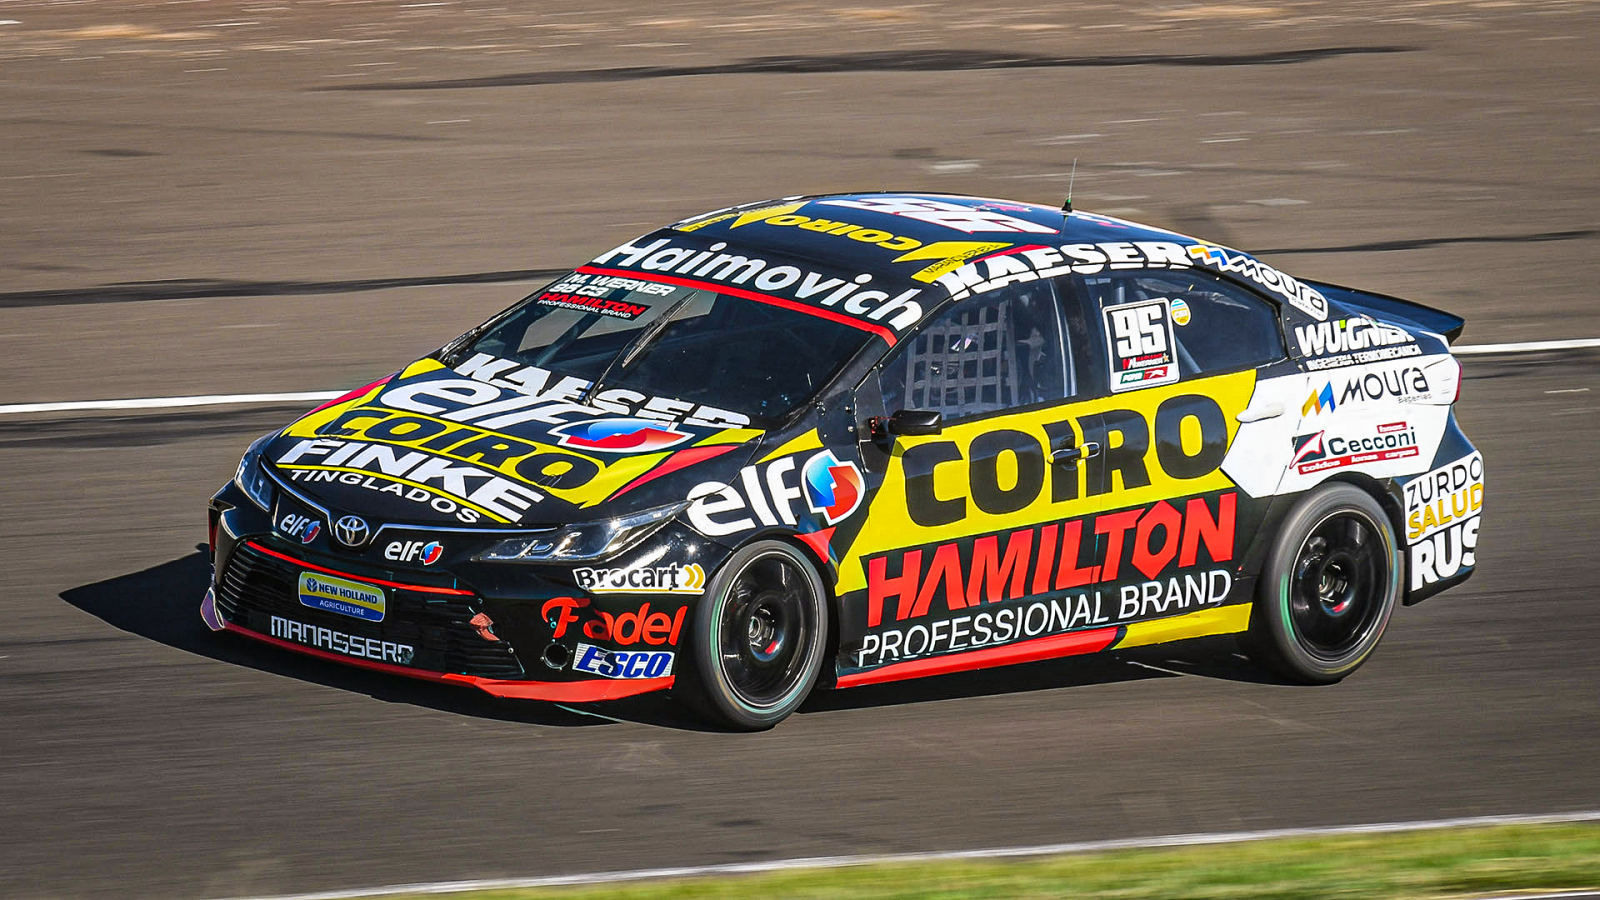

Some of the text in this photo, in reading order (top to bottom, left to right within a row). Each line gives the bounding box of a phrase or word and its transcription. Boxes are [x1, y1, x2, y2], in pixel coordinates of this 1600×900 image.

[764, 215, 922, 251] COIRO
[590, 276, 677, 297] WERNER
[592, 234, 923, 331] Haimovich
[937, 241, 1194, 301] KAESER
[537, 300, 631, 318] PROFESSIONAL BRAND
[539, 293, 645, 316] HAMILTON
[1110, 304, 1167, 358] 95
[381, 379, 605, 430] elf
[321, 411, 600, 490] COIRO
[902, 394, 1228, 527] COIRO
[1301, 460, 1341, 472] toldos
[1328, 426, 1416, 456] Cecconi
[276, 438, 545, 523] FINKE
[290, 470, 481, 524] TINGLADOS
[686, 456, 802, 536] elf
[1407, 456, 1482, 512] ZURDO
[280, 513, 310, 536] elf
[1408, 482, 1484, 539] SALUD
[384, 541, 424, 562] elf
[577, 564, 680, 588] Brocart
[867, 493, 1237, 628] HAMILTON
[319, 583, 378, 604] NEW HOLLAND
[319, 599, 365, 615] AGRICULTURE
[858, 569, 1232, 667] PROFESSIONAL BRAND
[541, 596, 688, 646] Fadel
